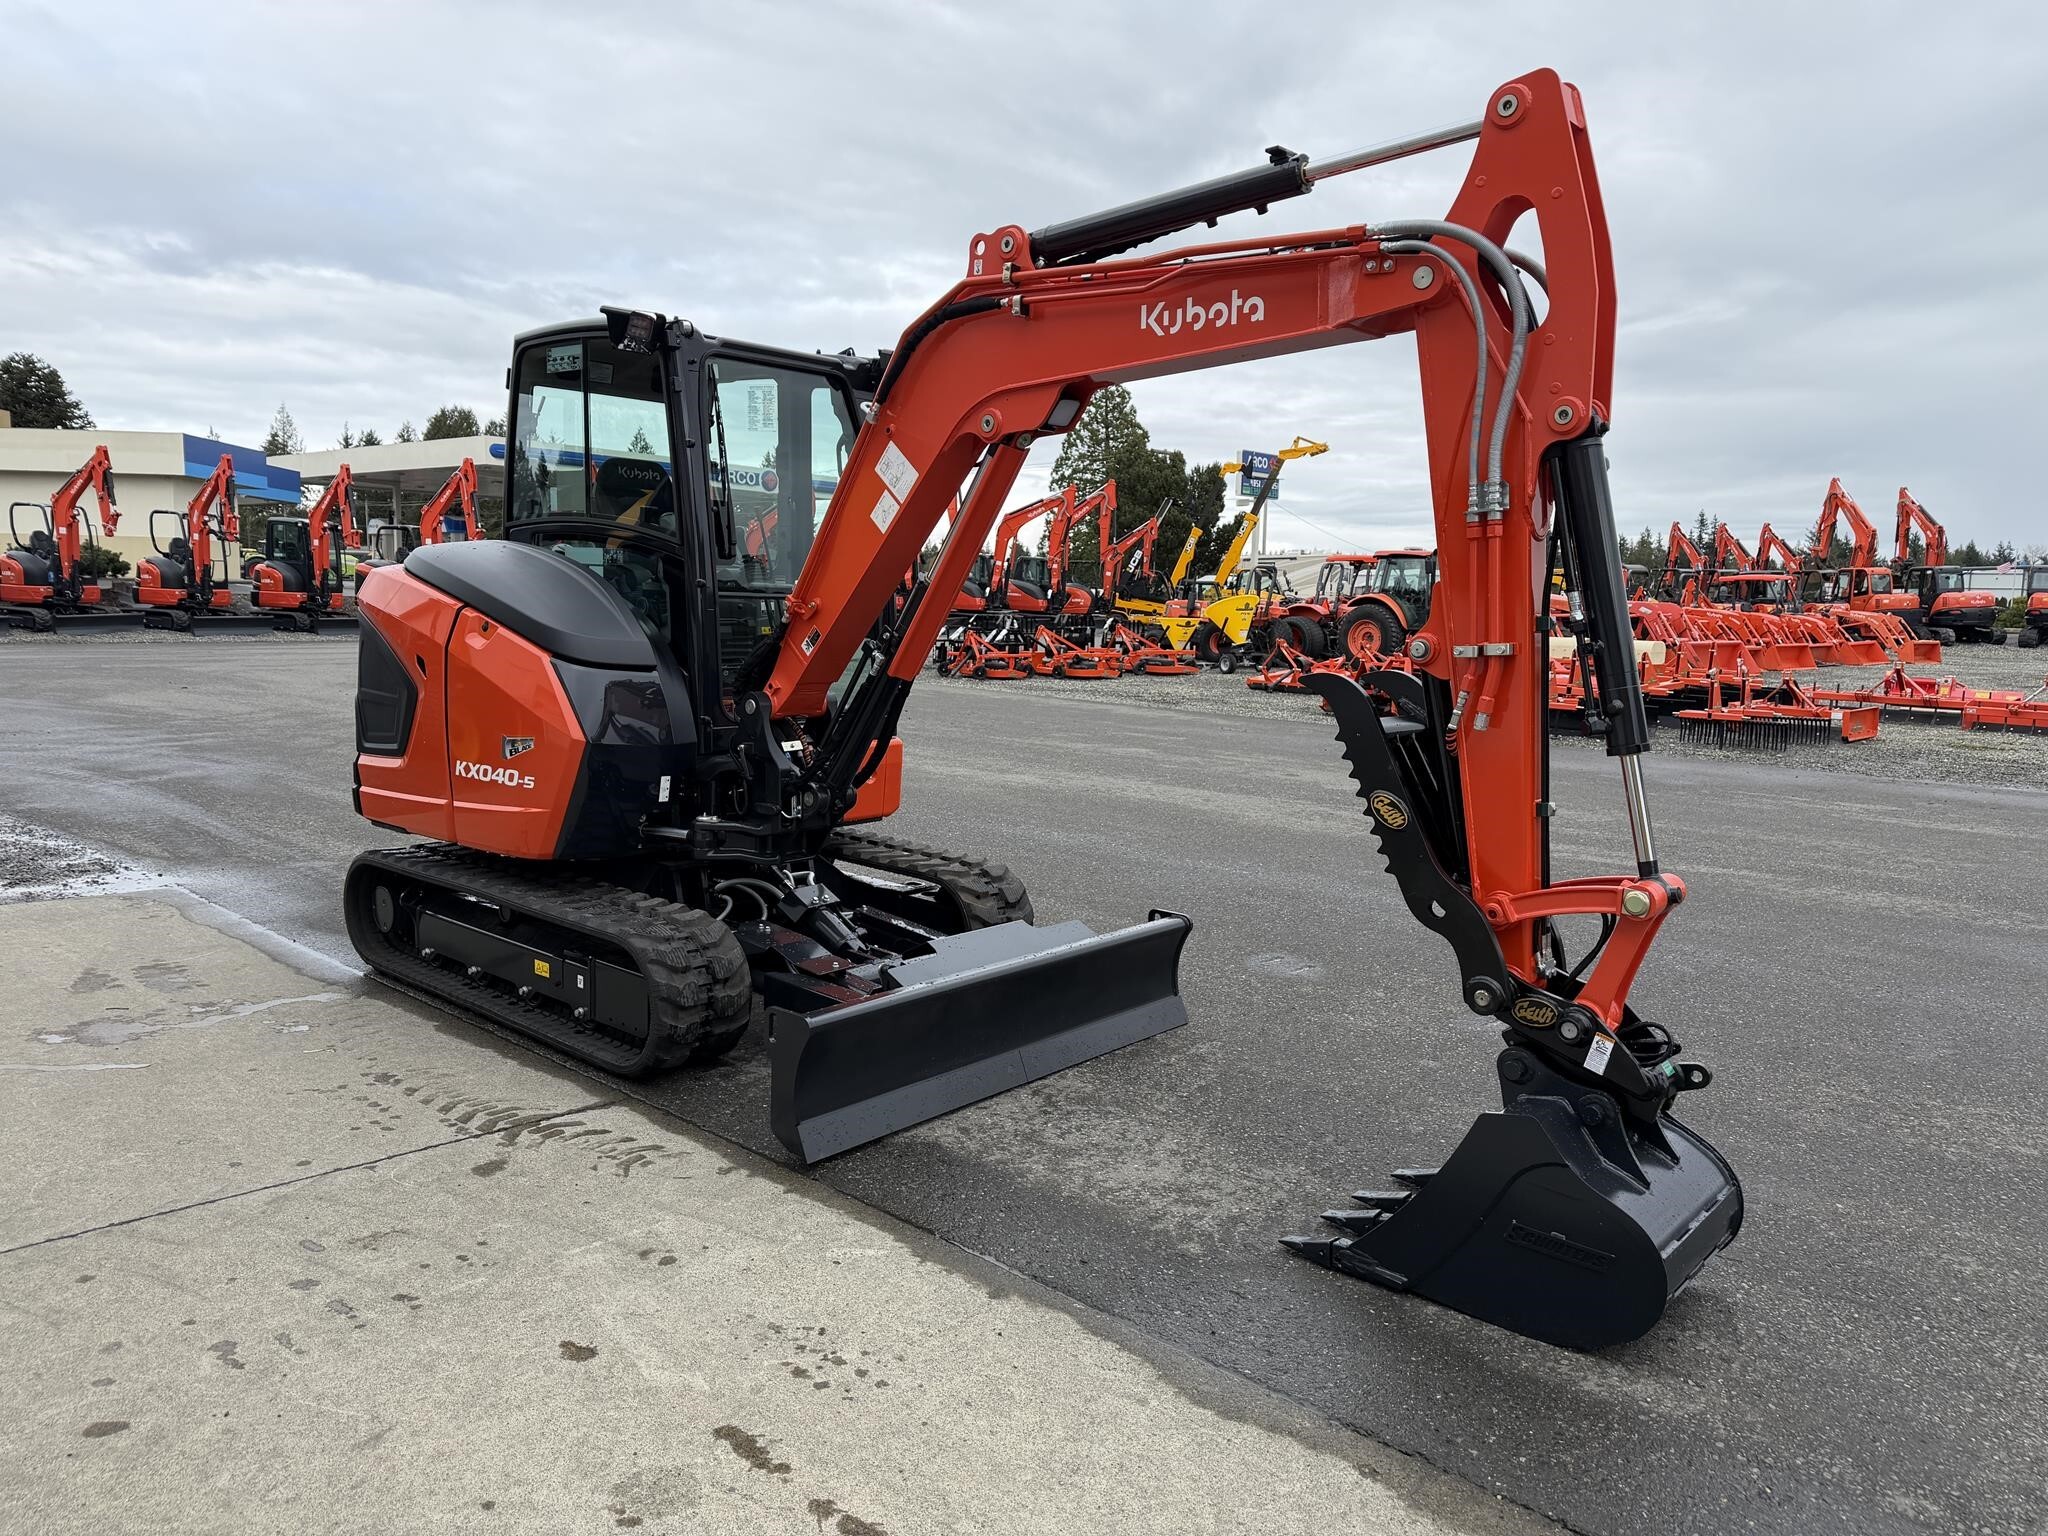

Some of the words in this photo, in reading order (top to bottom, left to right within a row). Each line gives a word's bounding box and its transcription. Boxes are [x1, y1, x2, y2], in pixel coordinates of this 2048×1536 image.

[1140, 289, 1265, 336] Kubota
[619, 466, 661, 480] Kubota
[719, 470, 757, 485] RCO
[1238, 520, 1250, 538] JCB
[1185, 536, 1196, 554] JCB
[1127, 549, 1144, 573] JCB
[455, 760, 535, 789] KX040-5
